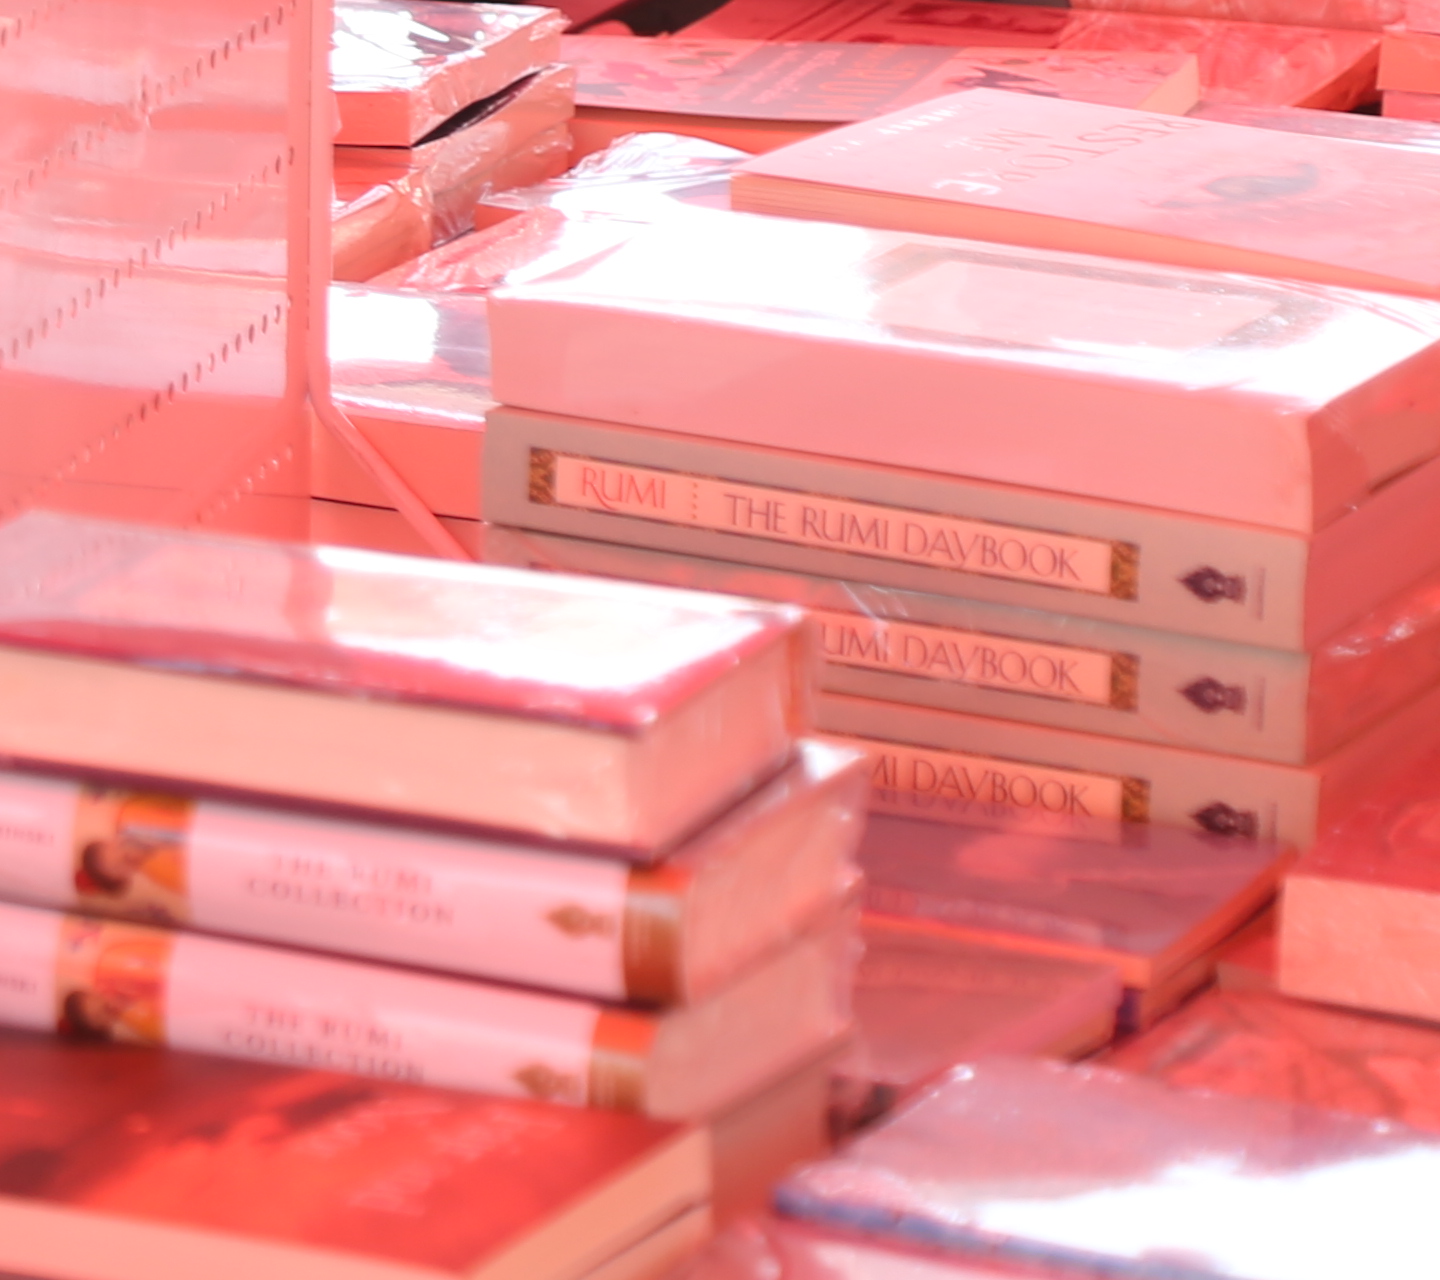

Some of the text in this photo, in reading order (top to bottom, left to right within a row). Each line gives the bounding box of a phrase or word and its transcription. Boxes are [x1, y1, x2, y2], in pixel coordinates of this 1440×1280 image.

[932, 117, 1202, 196] RESTORE
[581, 466, 1083, 582] RUMI THE RUMI DAYBOOK
[818, 621, 1083, 695] UMI DAYBOOK
[910, 755, 1093, 818] DAYBOOK
[245, 876, 456, 926] COLLECTION
[222, 1028, 426, 1083] COLLECTION
[243, 999, 405, 1051] THE RUMI
